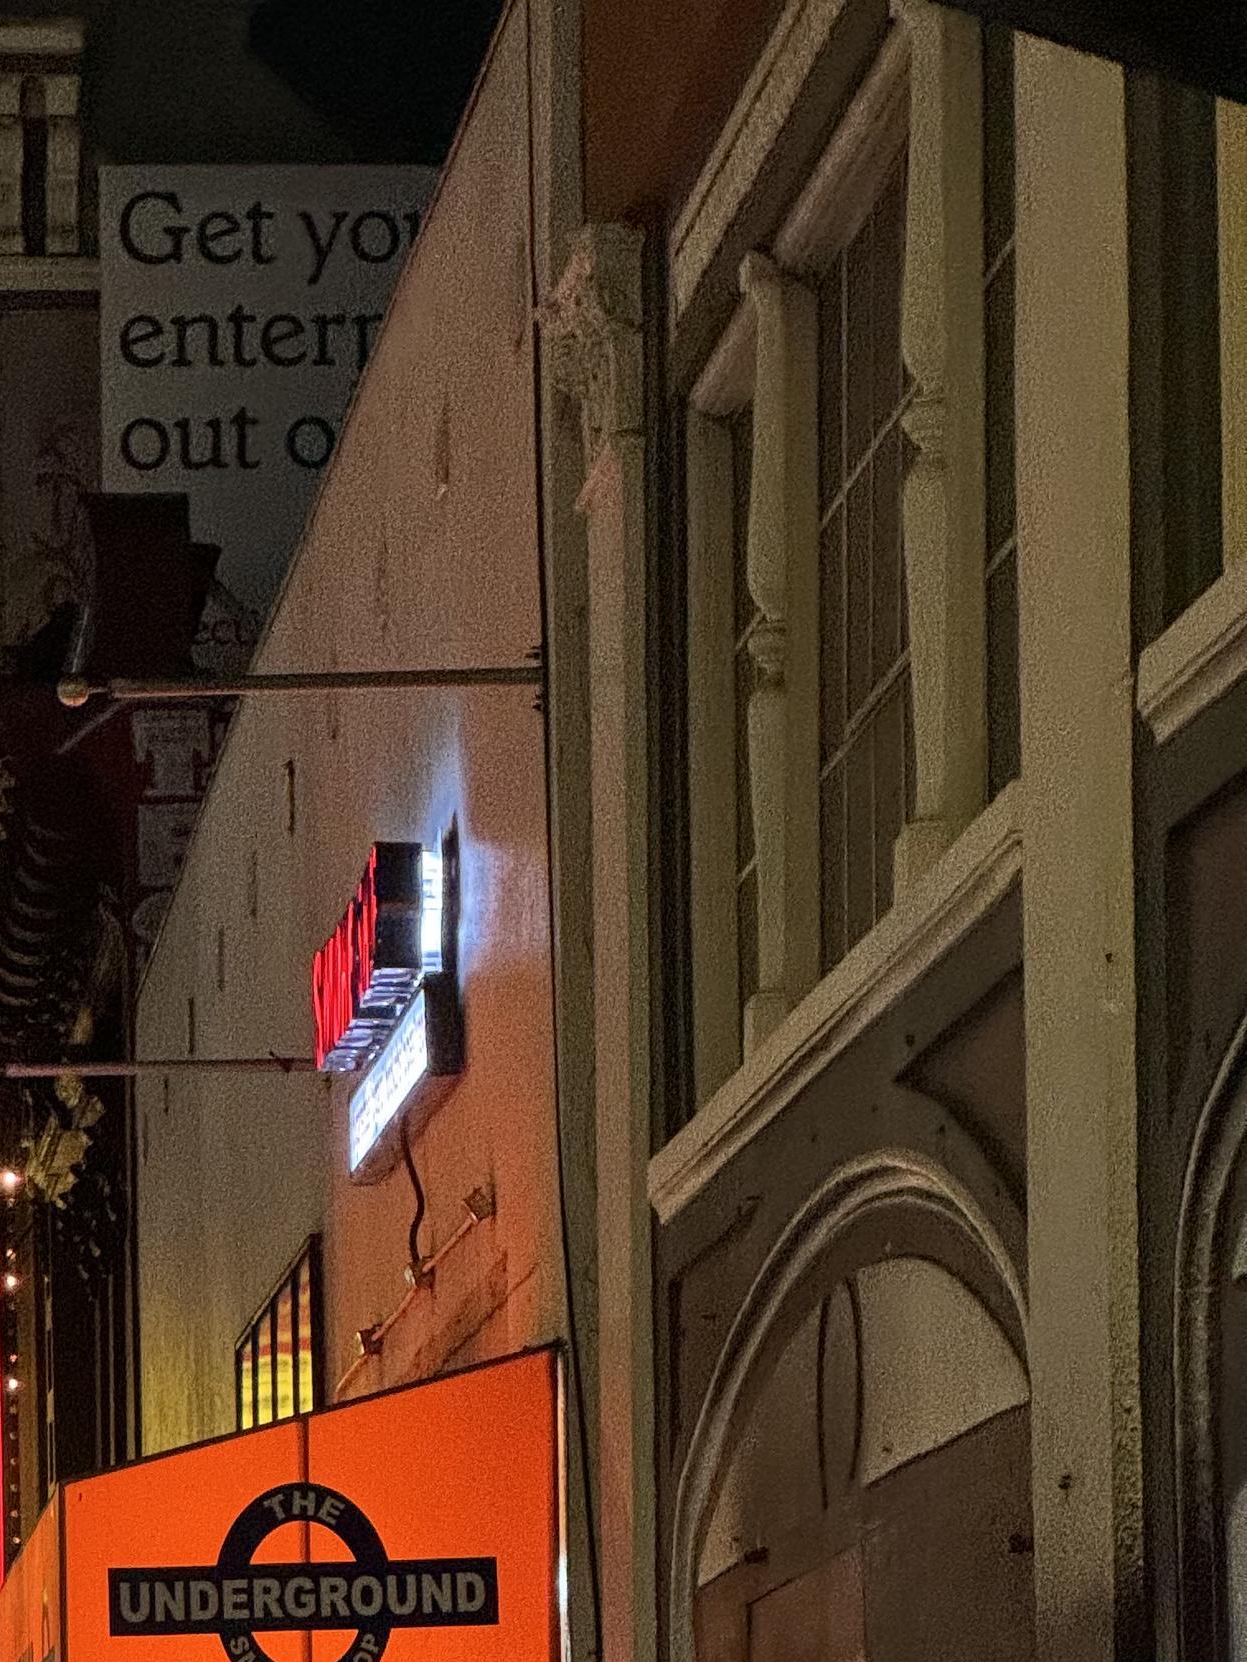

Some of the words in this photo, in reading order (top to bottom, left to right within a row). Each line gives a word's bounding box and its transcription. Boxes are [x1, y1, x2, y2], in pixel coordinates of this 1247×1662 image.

[119, 192, 276, 264] Get
[120, 407, 260, 470] out
[263, 1490, 346, 1525] THE
[118, 1572, 486, 1623] UNDERGROUND
